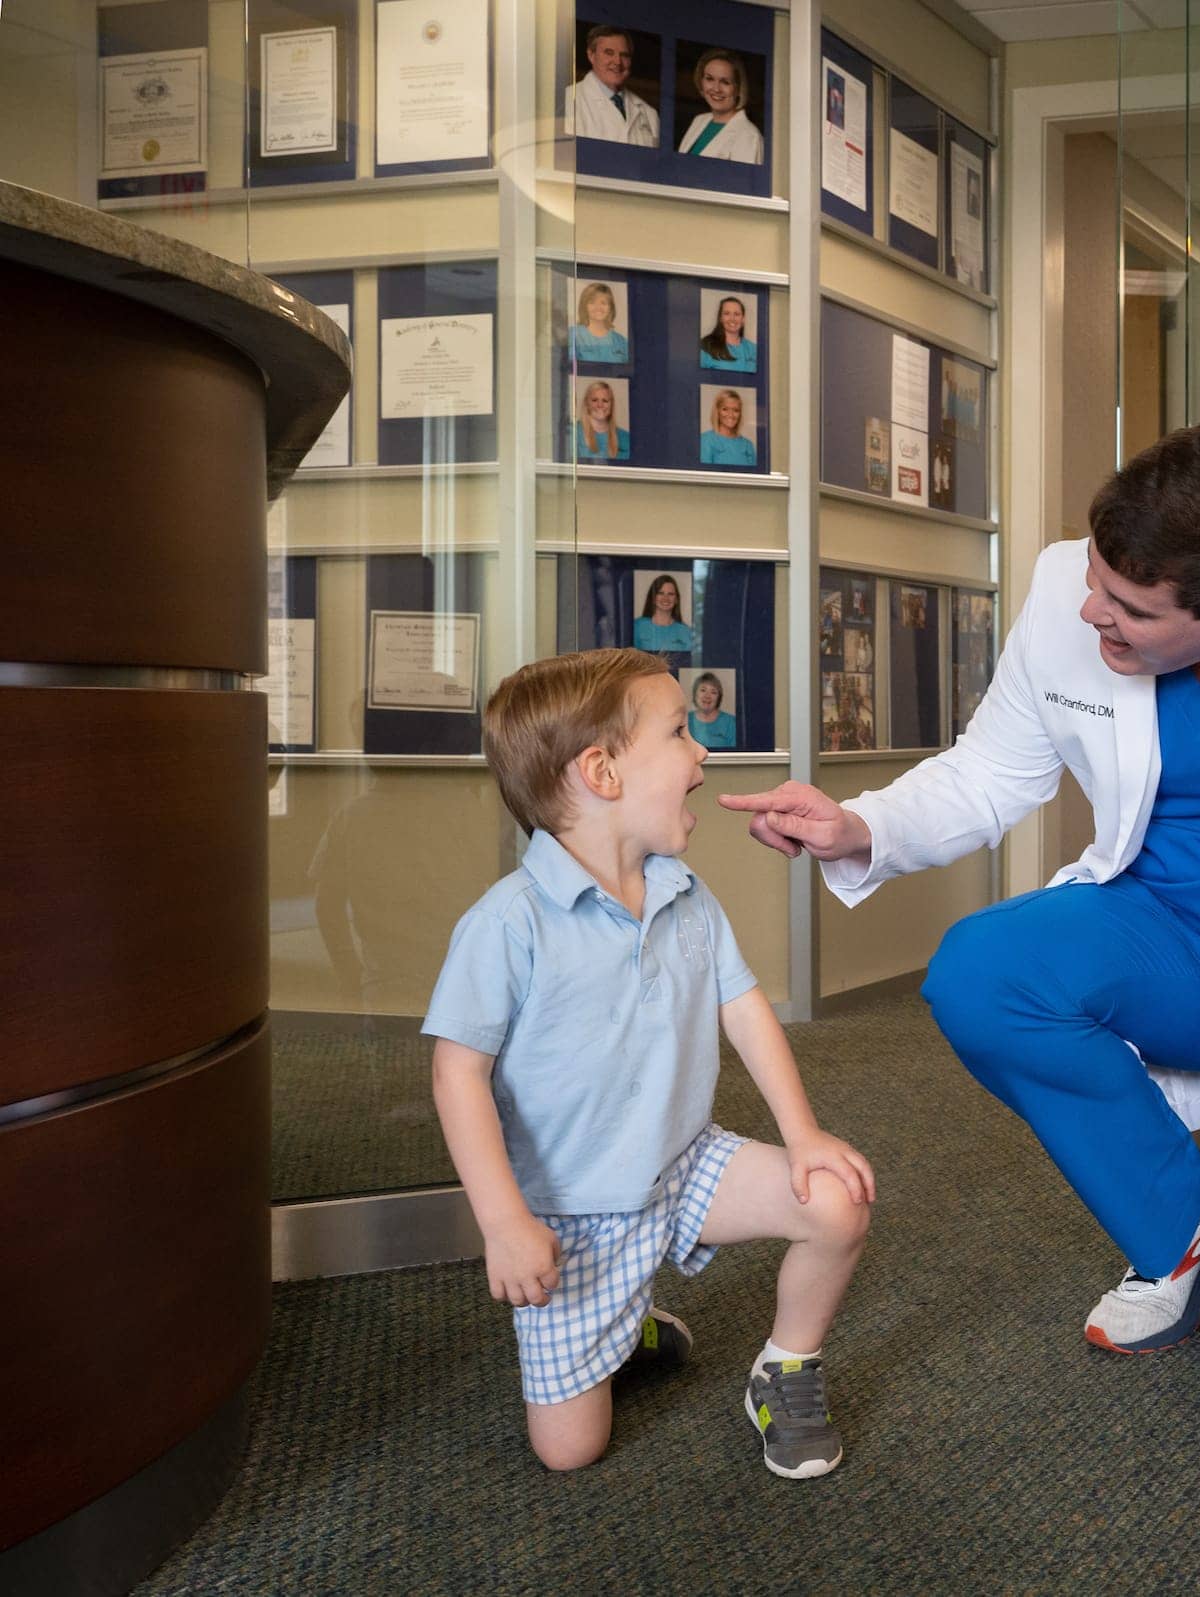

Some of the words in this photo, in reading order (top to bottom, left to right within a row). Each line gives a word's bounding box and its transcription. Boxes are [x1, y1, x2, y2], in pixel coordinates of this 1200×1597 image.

[1044, 690, 1058, 703] Will
[1059, 695, 1096, 716] Cranford,
[1098, 704, 1115, 718] DM
